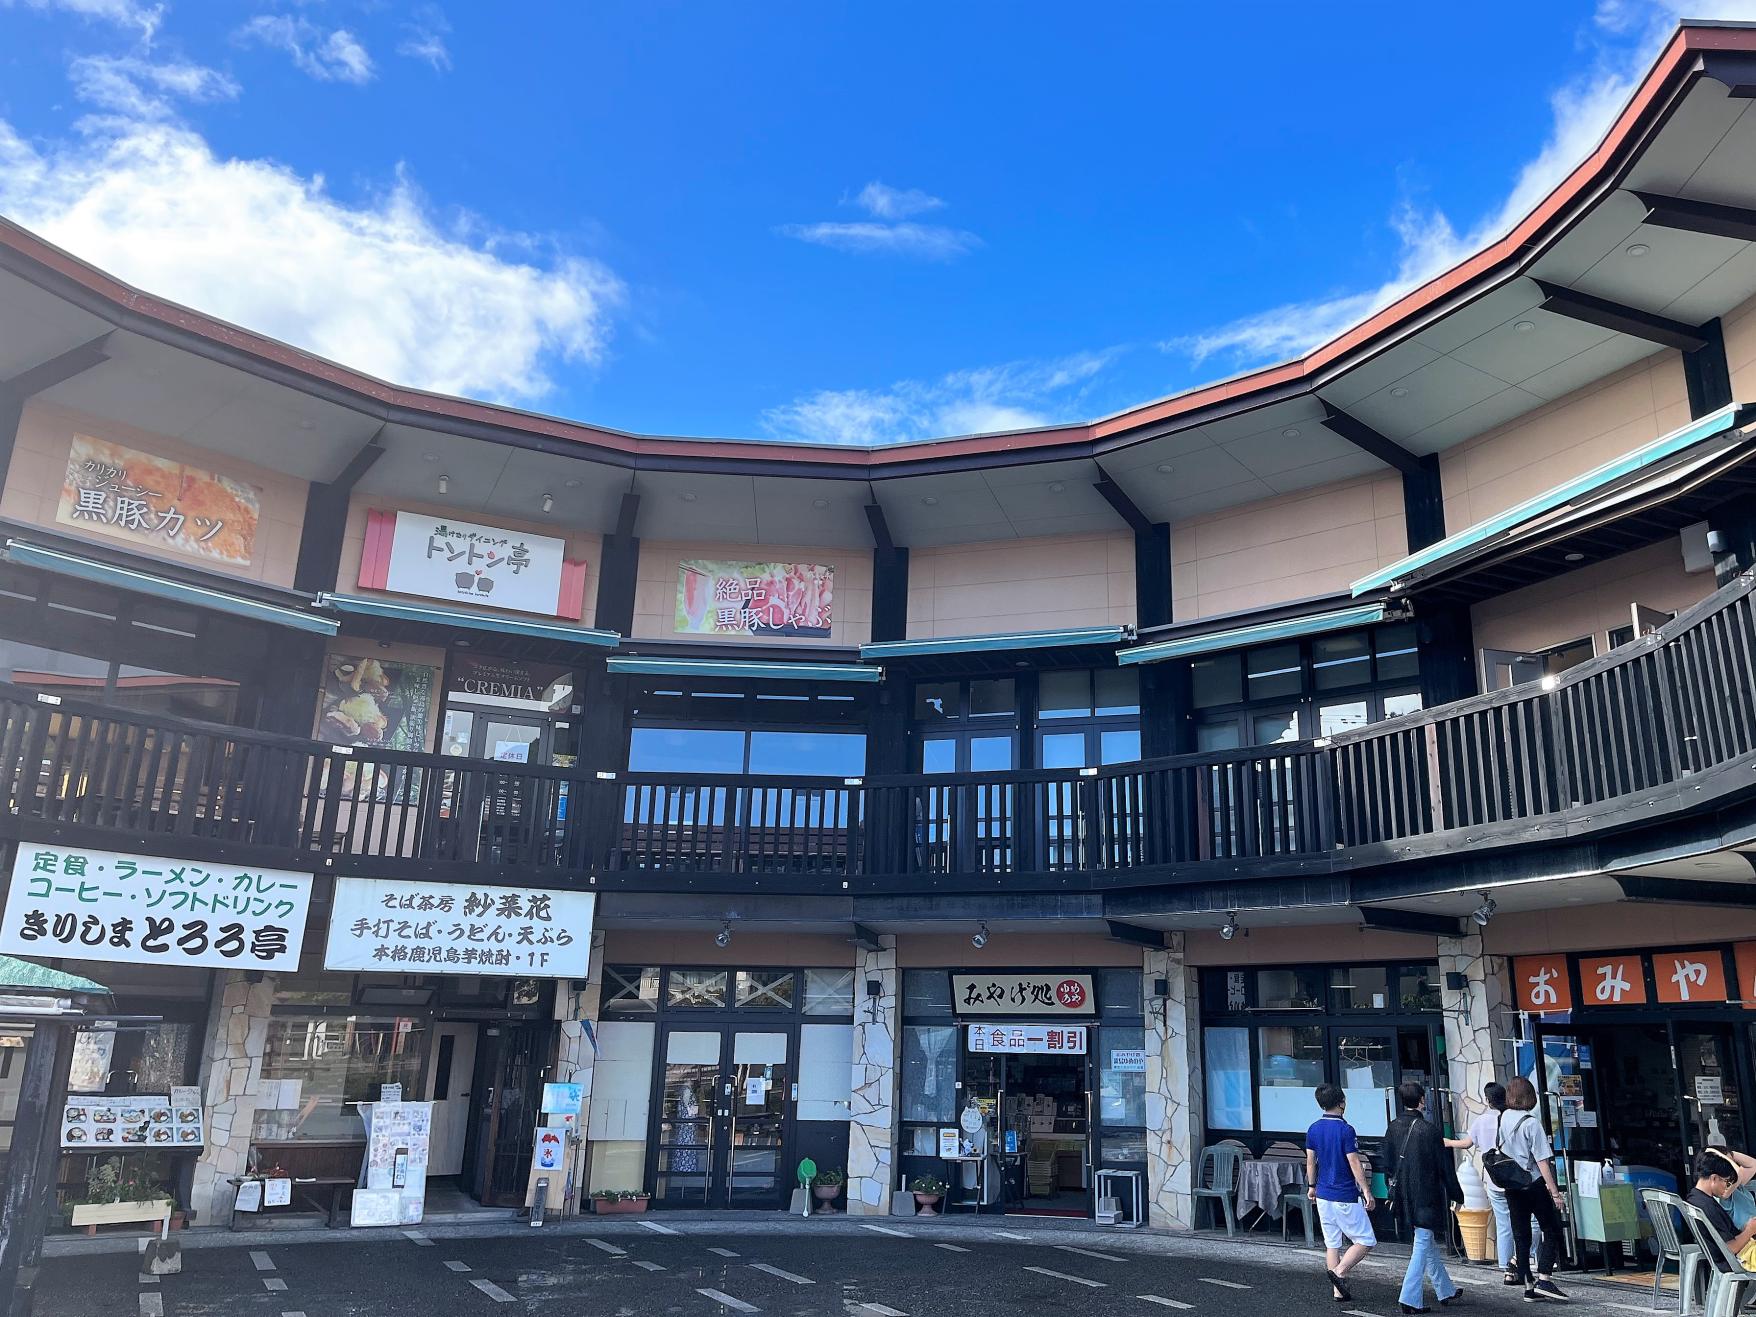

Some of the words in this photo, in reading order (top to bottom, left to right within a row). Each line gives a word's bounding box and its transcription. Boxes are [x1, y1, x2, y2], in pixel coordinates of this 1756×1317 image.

[84, 460, 127, 480] カリカリ
[95, 475, 163, 497] ジューシー
[72, 487, 223, 541] 黒豚カツ
[427, 535, 531, 575] トントン亭
[715, 577, 767, 602] 絶品
[714, 604, 833, 632] 黒豚しゃぶ
[381, 893, 455, 913] そば茶房
[19, 909, 290, 961] きりしまとろろ亭
[350, 917, 574, 947] 手打そば・うどん・天ぷら
[963, 982, 1056, 1007] みやげ処
[974, 1025, 986, 1051] 本日
[990, 1028, 1083, 1051] 食品一割引
